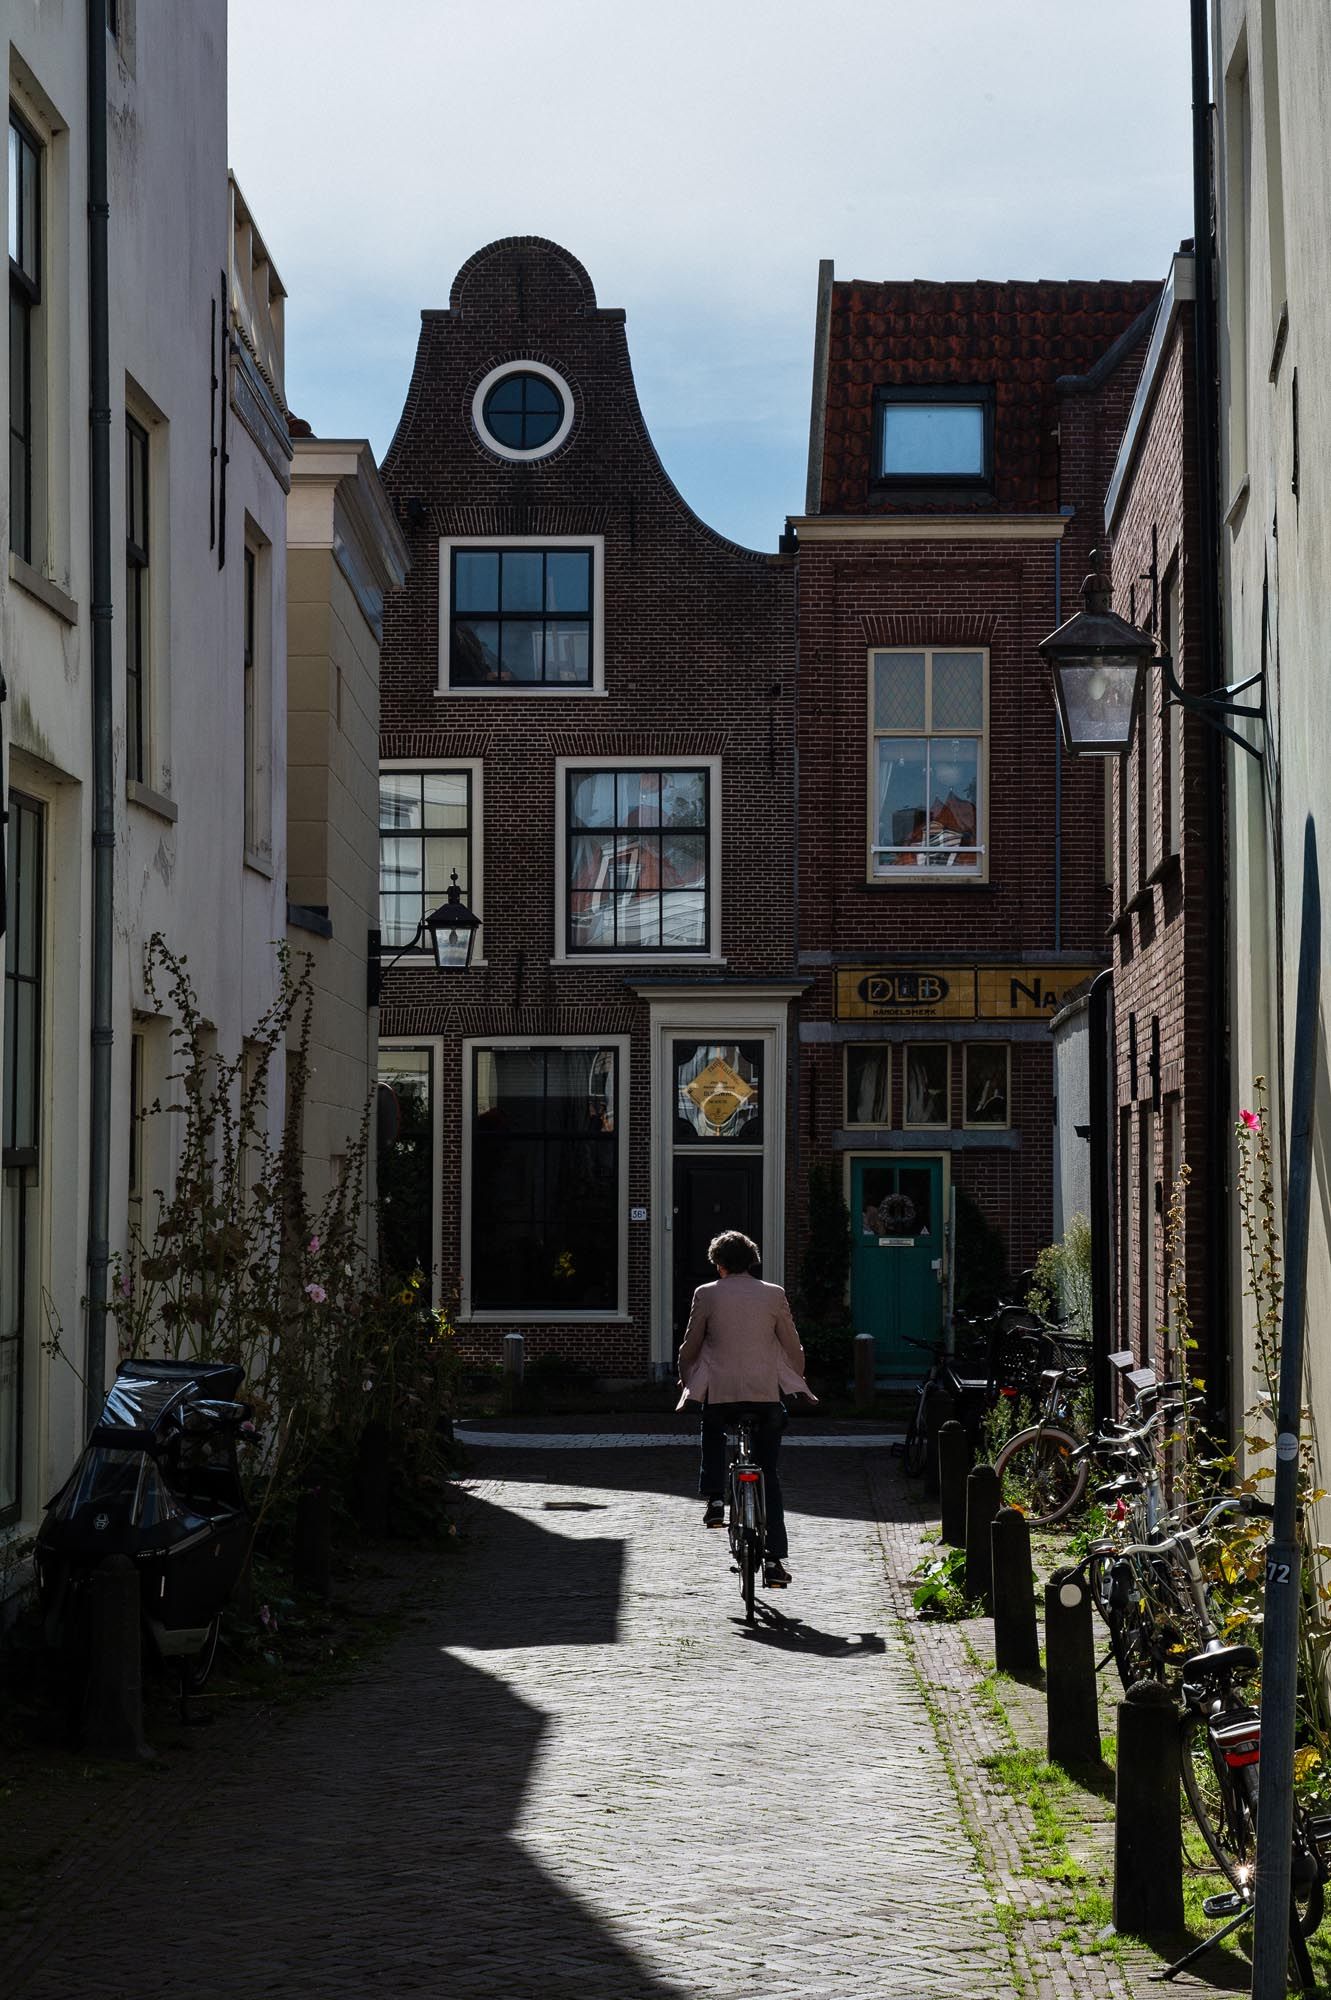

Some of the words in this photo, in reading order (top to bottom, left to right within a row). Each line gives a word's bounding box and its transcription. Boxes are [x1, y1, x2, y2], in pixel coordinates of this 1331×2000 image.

[867, 977, 942, 1002] DLB
[872, 1008, 937, 1016] HANDELSMERK
[1267, 1562, 1290, 1584] 72
